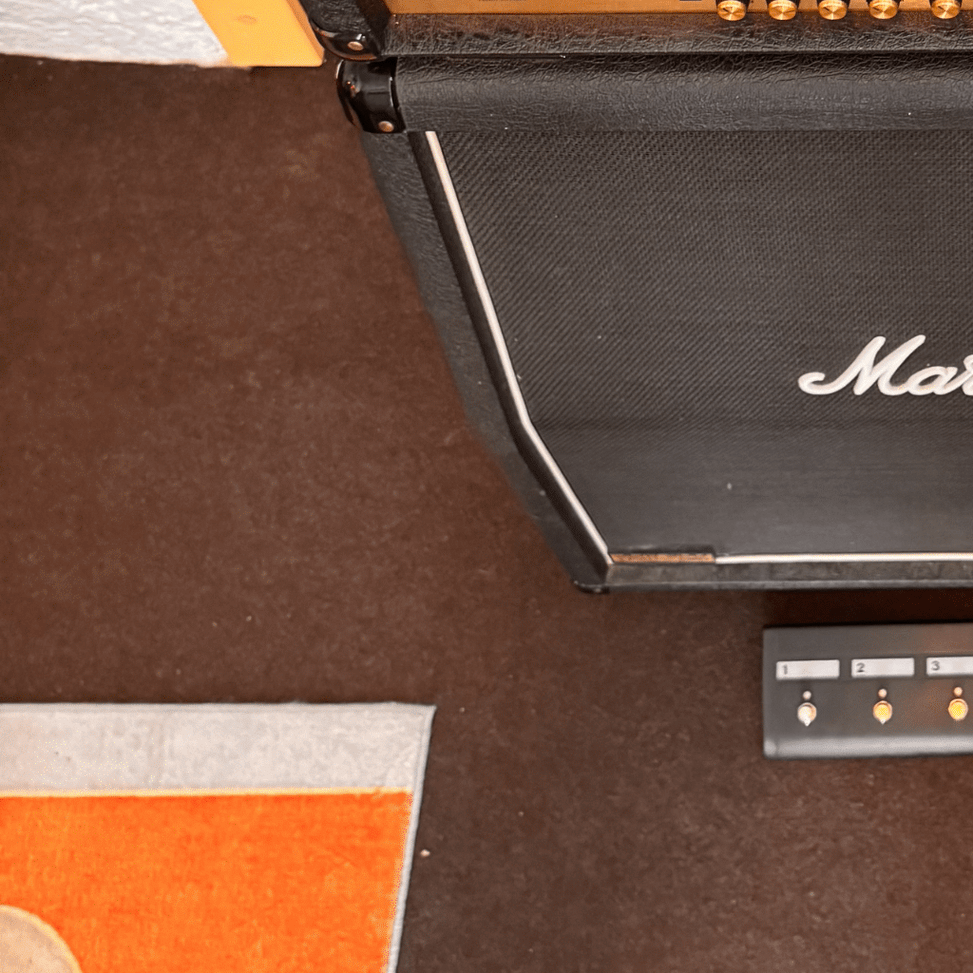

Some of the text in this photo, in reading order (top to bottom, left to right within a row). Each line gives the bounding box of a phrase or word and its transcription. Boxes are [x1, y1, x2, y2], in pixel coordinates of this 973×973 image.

[782, 665, 788, 675] 1
[856, 663, 865, 673] 2
[931, 661, 940, 671] 3
